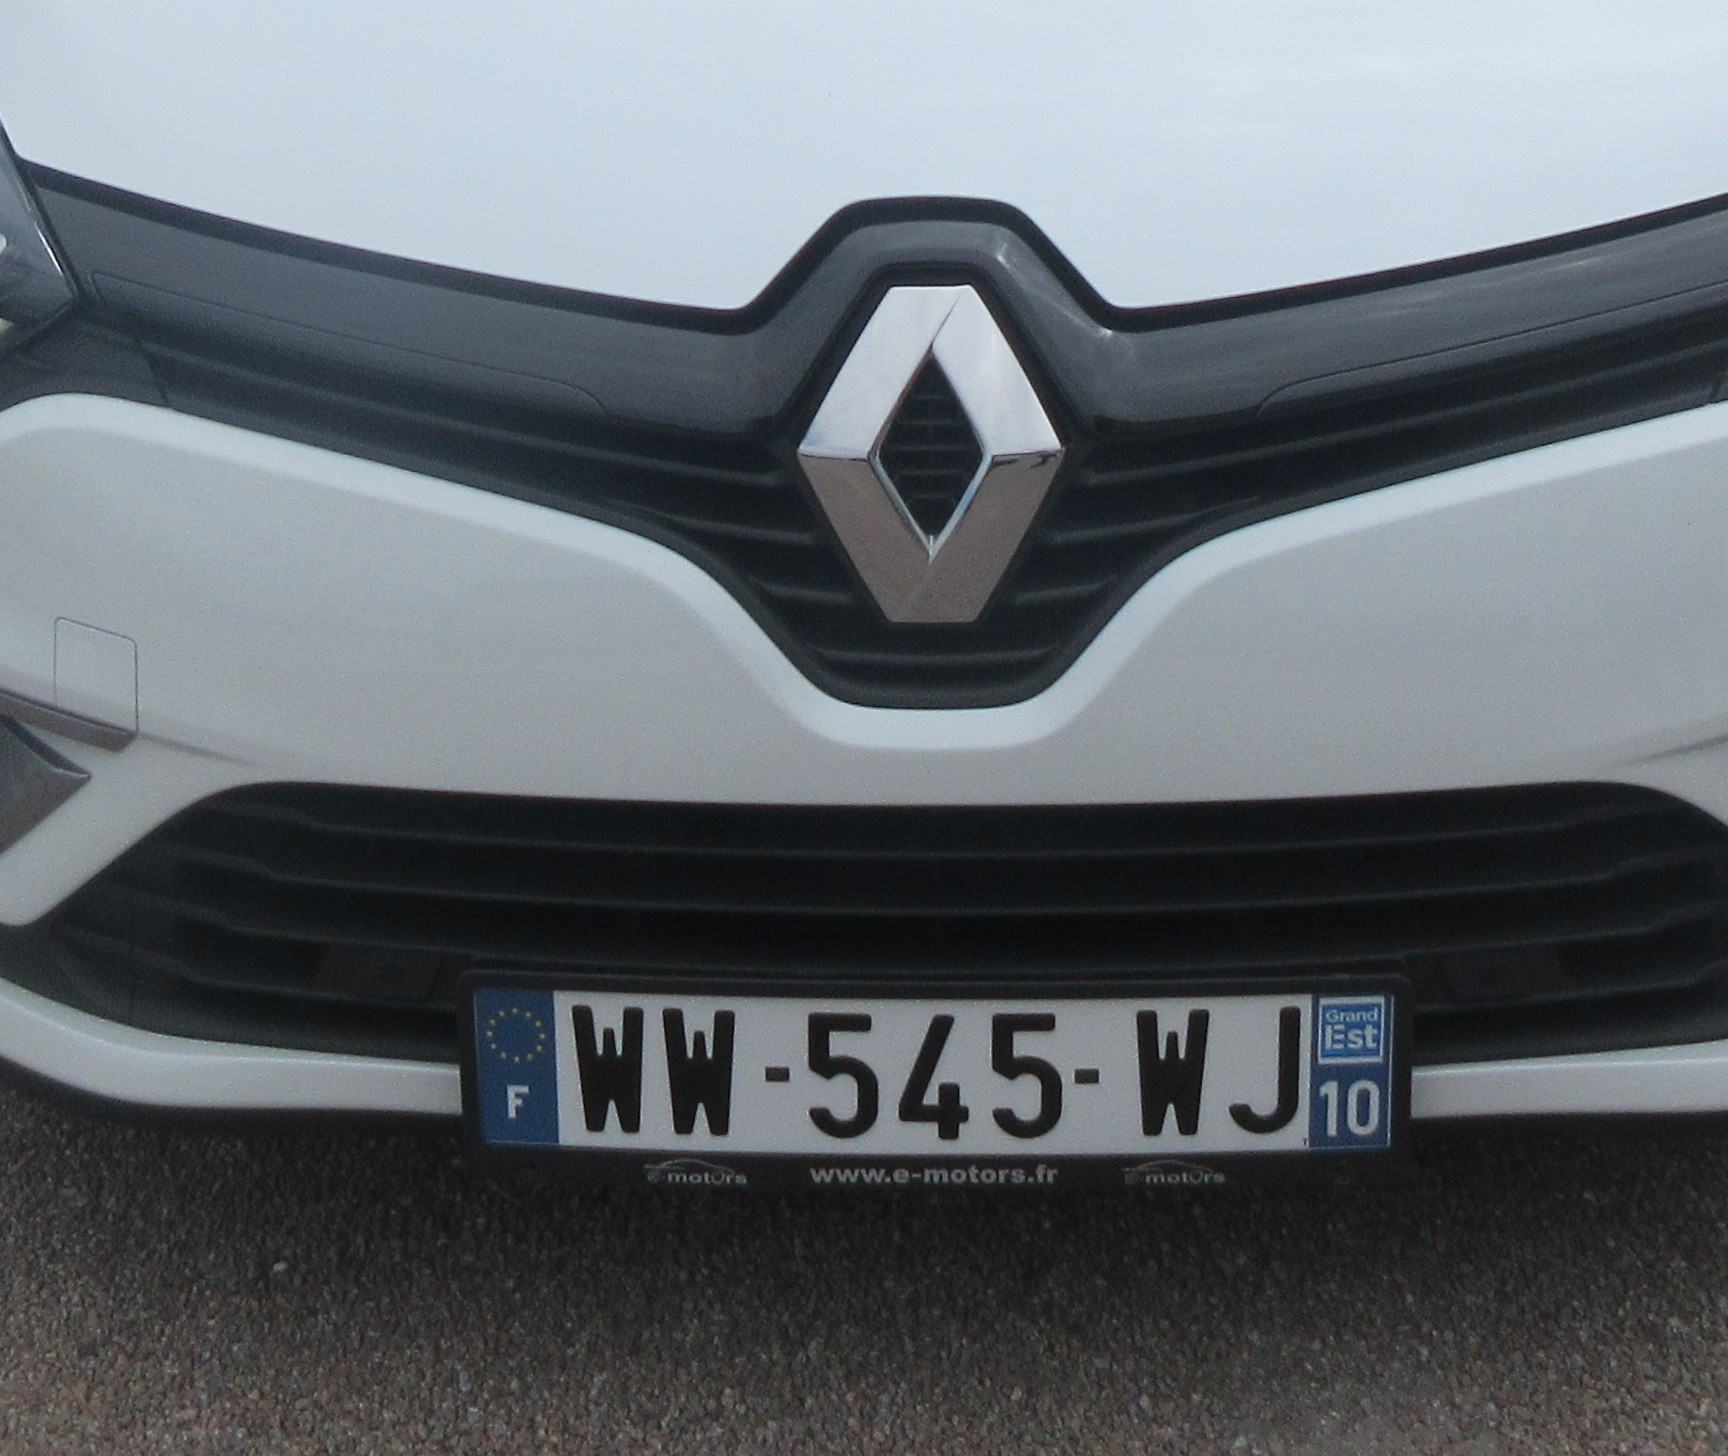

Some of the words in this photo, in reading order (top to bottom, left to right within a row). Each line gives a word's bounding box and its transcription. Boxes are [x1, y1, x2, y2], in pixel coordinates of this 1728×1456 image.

[1326, 1008, 1380, 1024] Grand
[1324, 1023, 1379, 1050] Est
[506, 1084, 530, 1119] F
[1318, 1079, 1381, 1138] 10
[809, 1164, 1059, 1186] www.e-motors.fr
